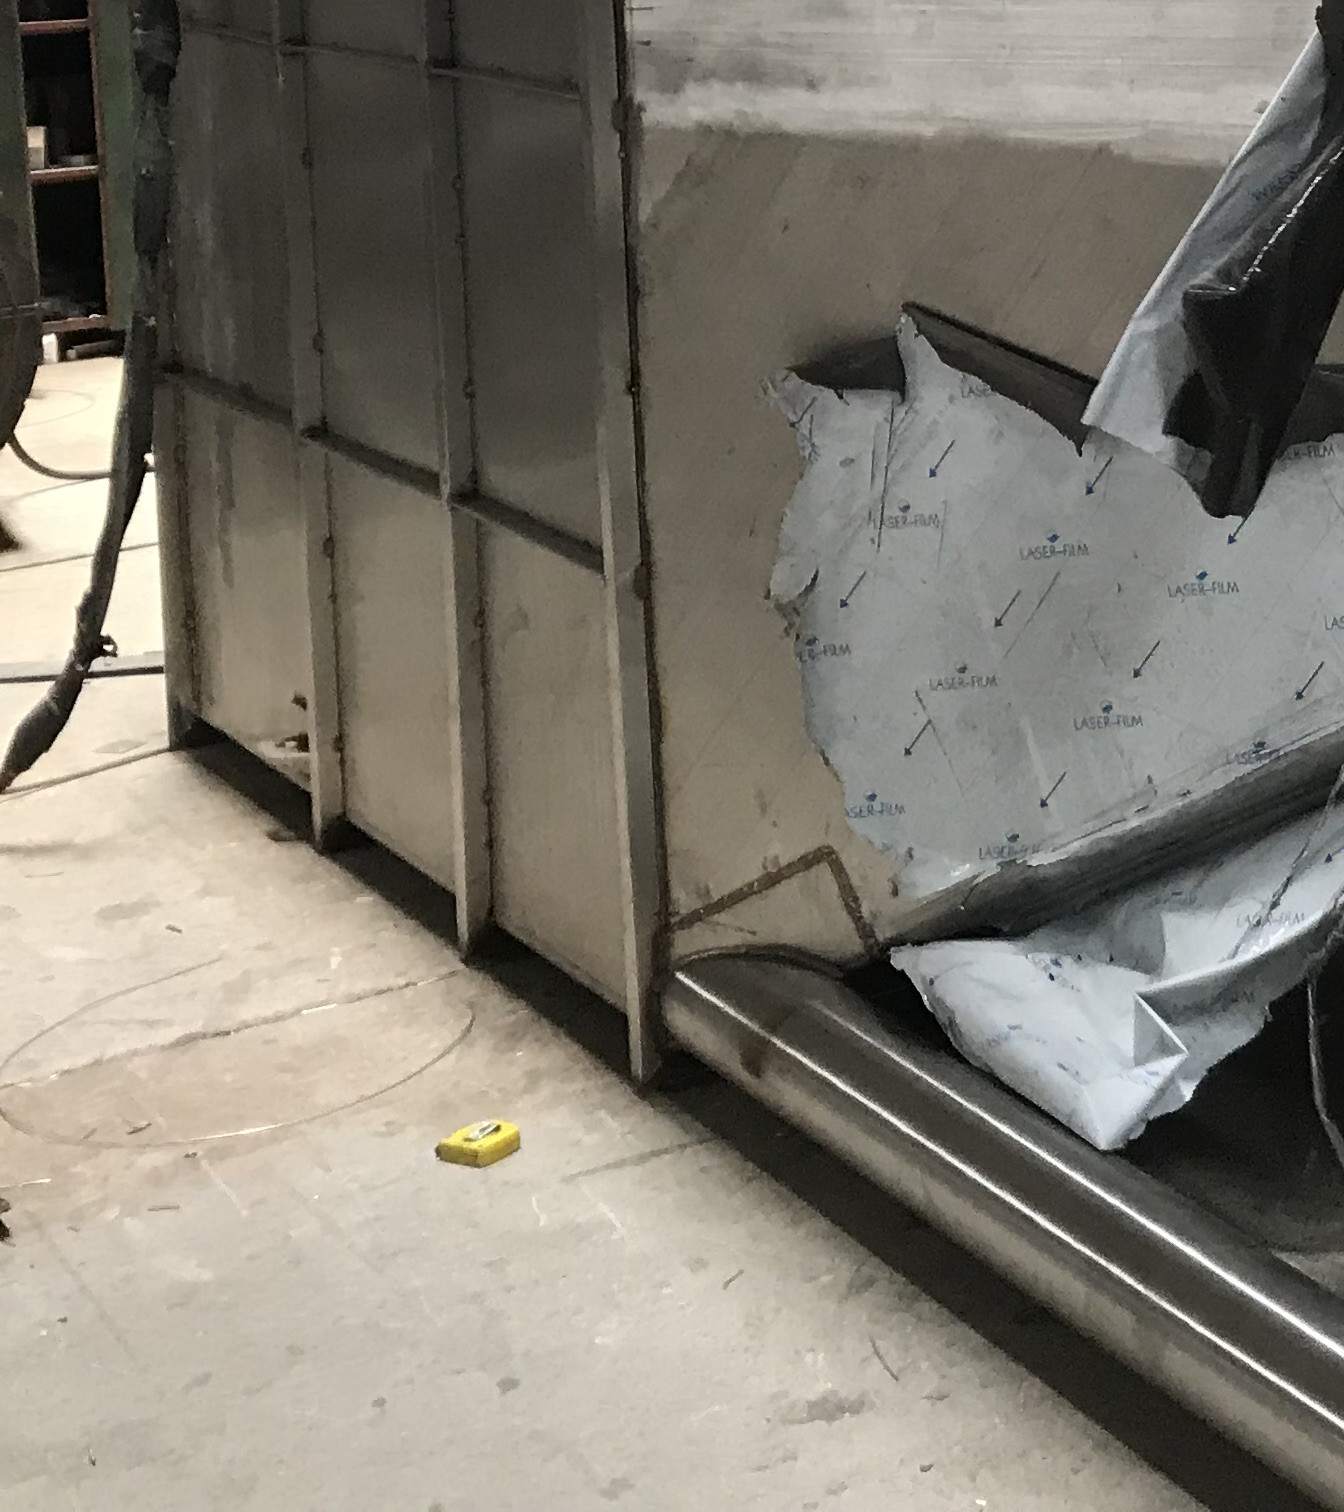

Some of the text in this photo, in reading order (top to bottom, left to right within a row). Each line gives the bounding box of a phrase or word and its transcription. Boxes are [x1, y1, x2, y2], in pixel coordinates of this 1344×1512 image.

[1019, 543, 1090, 562] LASER-FILM
[1167, 581, 1240, 598] LASER-FILM
[929, 672, 998, 692] LASER-FILM
[1073, 714, 1144, 731] LASER-FILM
